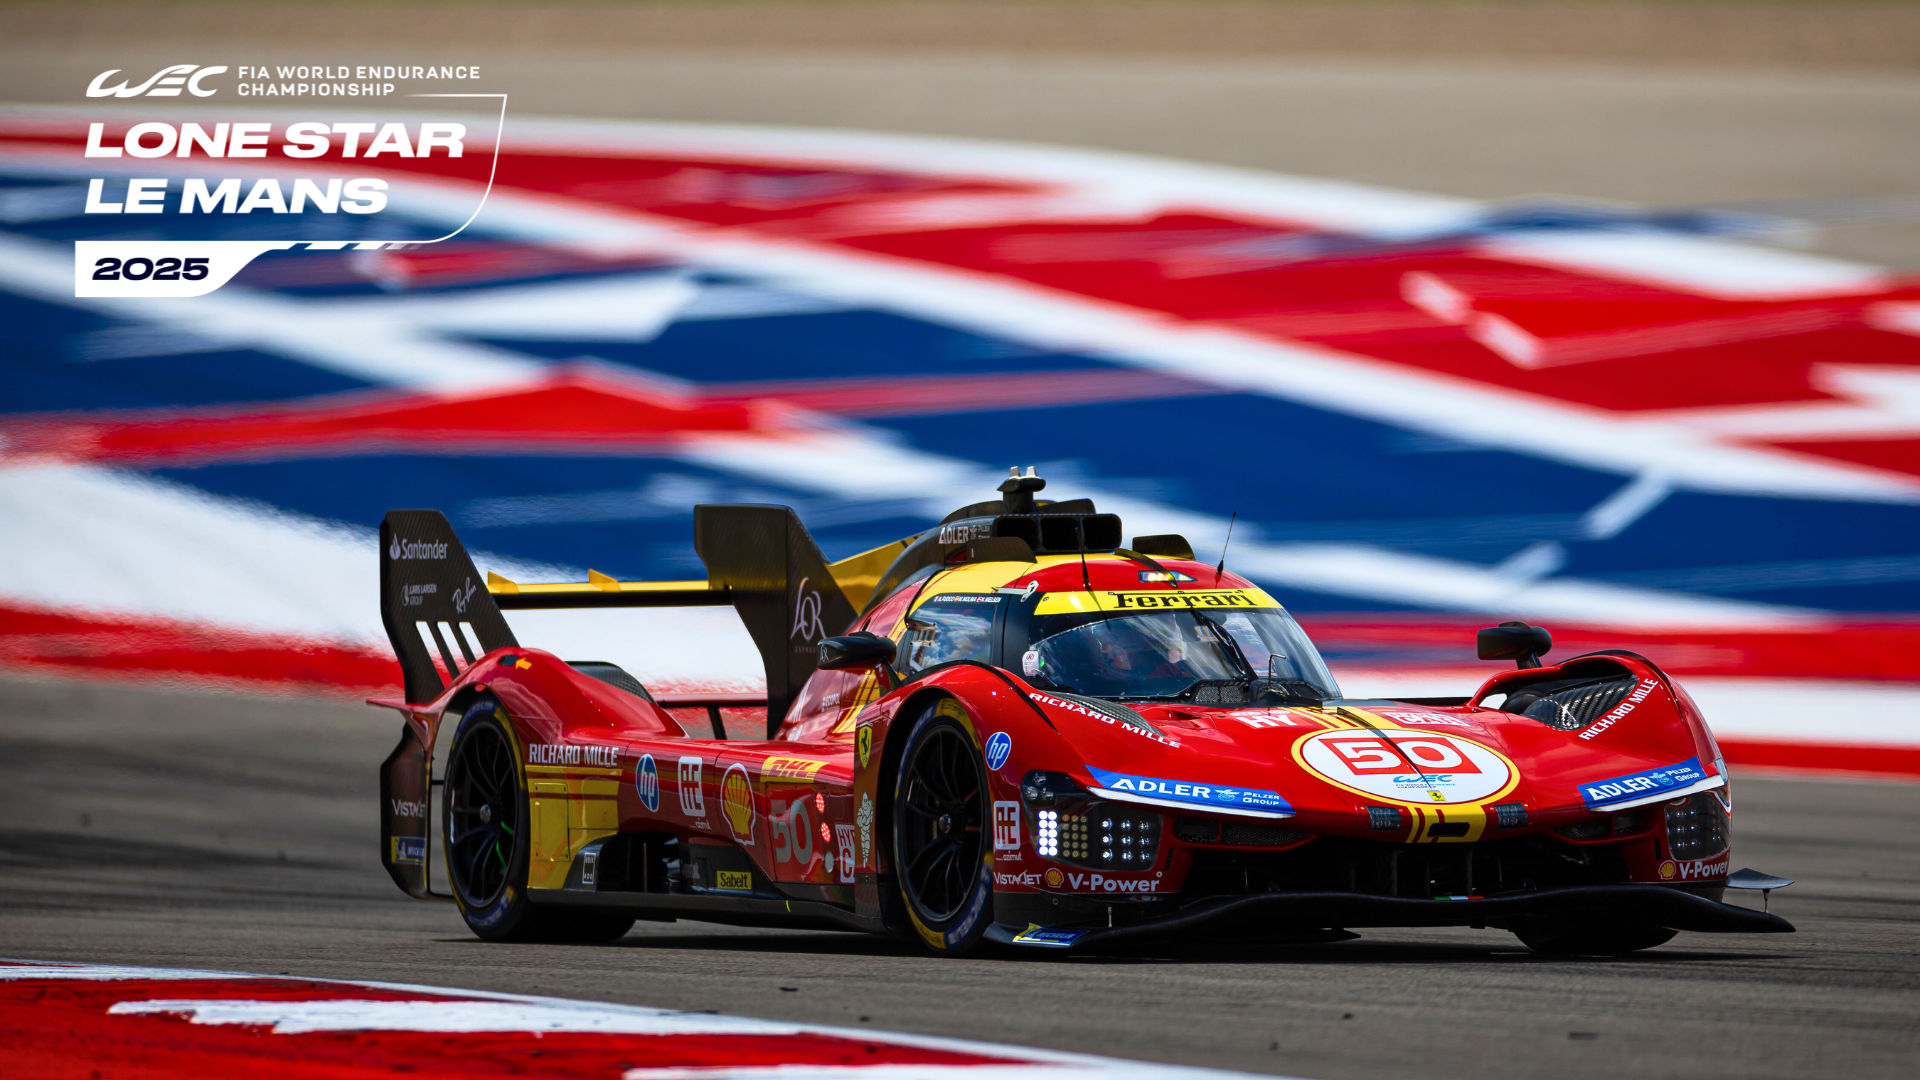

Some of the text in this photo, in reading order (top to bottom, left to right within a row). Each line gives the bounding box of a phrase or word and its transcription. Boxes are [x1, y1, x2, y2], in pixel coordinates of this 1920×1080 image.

[938, 526, 969, 545] ADLER
[401, 538, 448, 560] Santander
[409, 584, 438, 595] LARS LARSEN
[1109, 589, 1258, 609] Ferrari
[409, 595, 424, 606] GROUP
[1578, 678, 1659, 740] RICHARD MILLE
[1028, 692, 1182, 748] RICHARD MILLE
[1236, 714, 1298, 729] HY
[529, 743, 620, 767] RICHARD MILLE
[987, 732, 1009, 769] hp
[1331, 740, 1463, 769] 50
[767, 759, 815, 778] DHL
[1665, 767, 1693, 777] PELZER
[1674, 772, 1701, 783] GROUP
[639, 754, 657, 811] hp
[1393, 774, 1453, 783] WEC
[1110, 778, 1211, 799] ADLER
[1242, 791, 1280, 800] PELZER
[1585, 776, 1660, 801] ADLER
[1242, 797, 1280, 806] GROUP
[770, 798, 813, 865] 50
[1002, 850, 1023, 861] azimut
[720, 872, 749, 888] Sabelt
[993, 868, 1043, 885] VISTAJET
[1678, 861, 1729, 880] V-Power
[1067, 873, 1160, 891] V-Power
